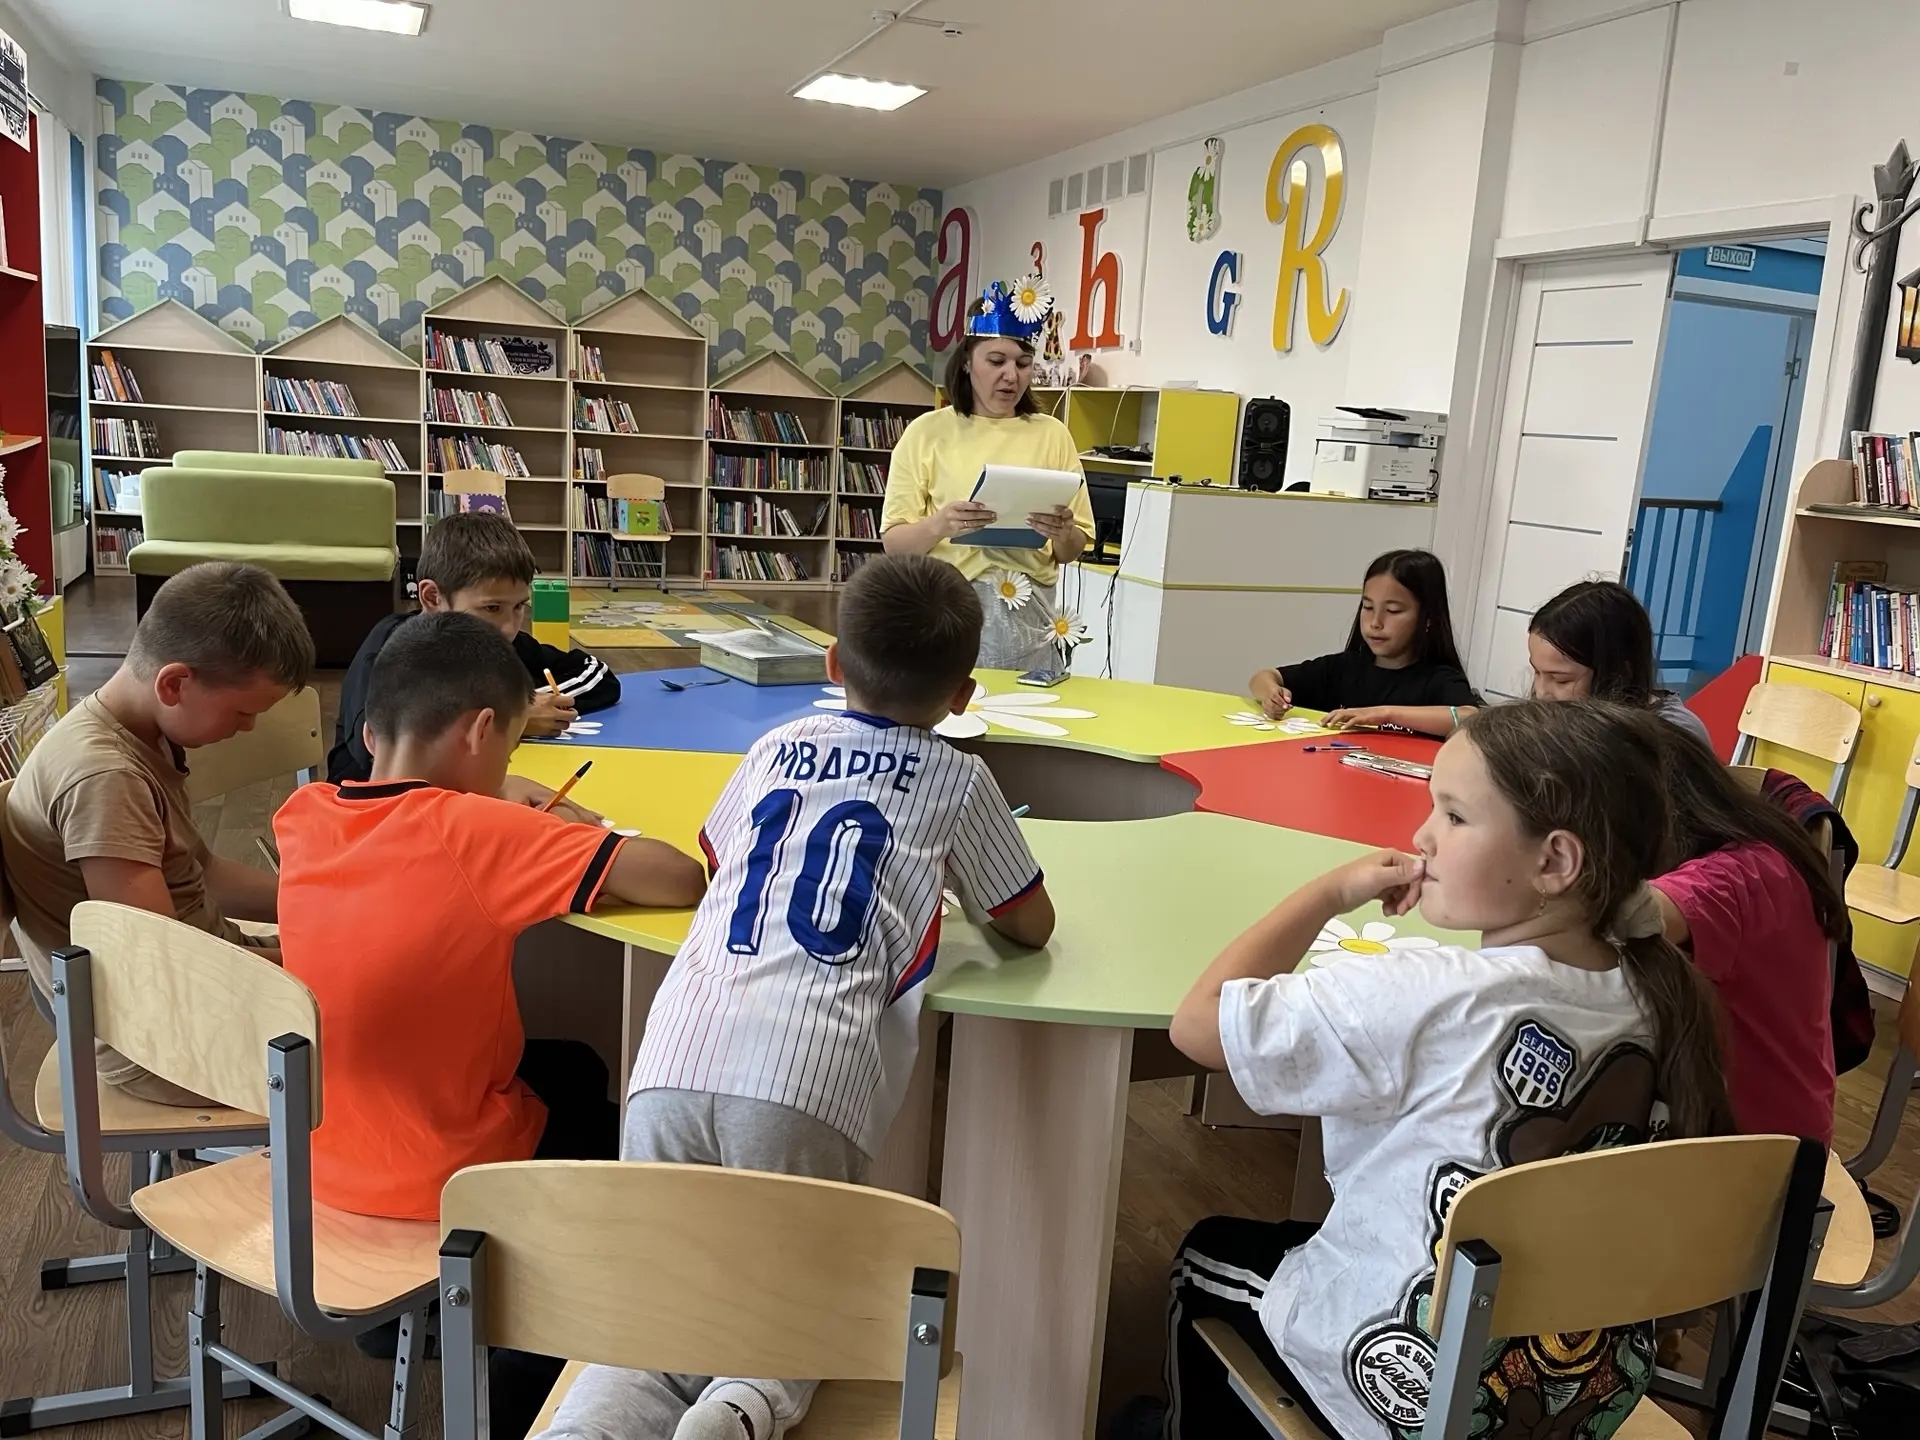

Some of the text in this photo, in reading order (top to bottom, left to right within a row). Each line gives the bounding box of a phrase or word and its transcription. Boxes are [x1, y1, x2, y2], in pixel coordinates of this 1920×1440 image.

[1265, 123, 1350, 352] R
[1712, 248, 1751, 266] ВЫХОД
[1069, 208, 1125, 351] h
[1206, 250, 1240, 336] G
[726, 788, 895, 966] 10
[1511, 1046, 1561, 1095] 1966
[1521, 1032, 1569, 1072] BEATLES
[1364, 1373, 1420, 1419] SPECIAL BEER
